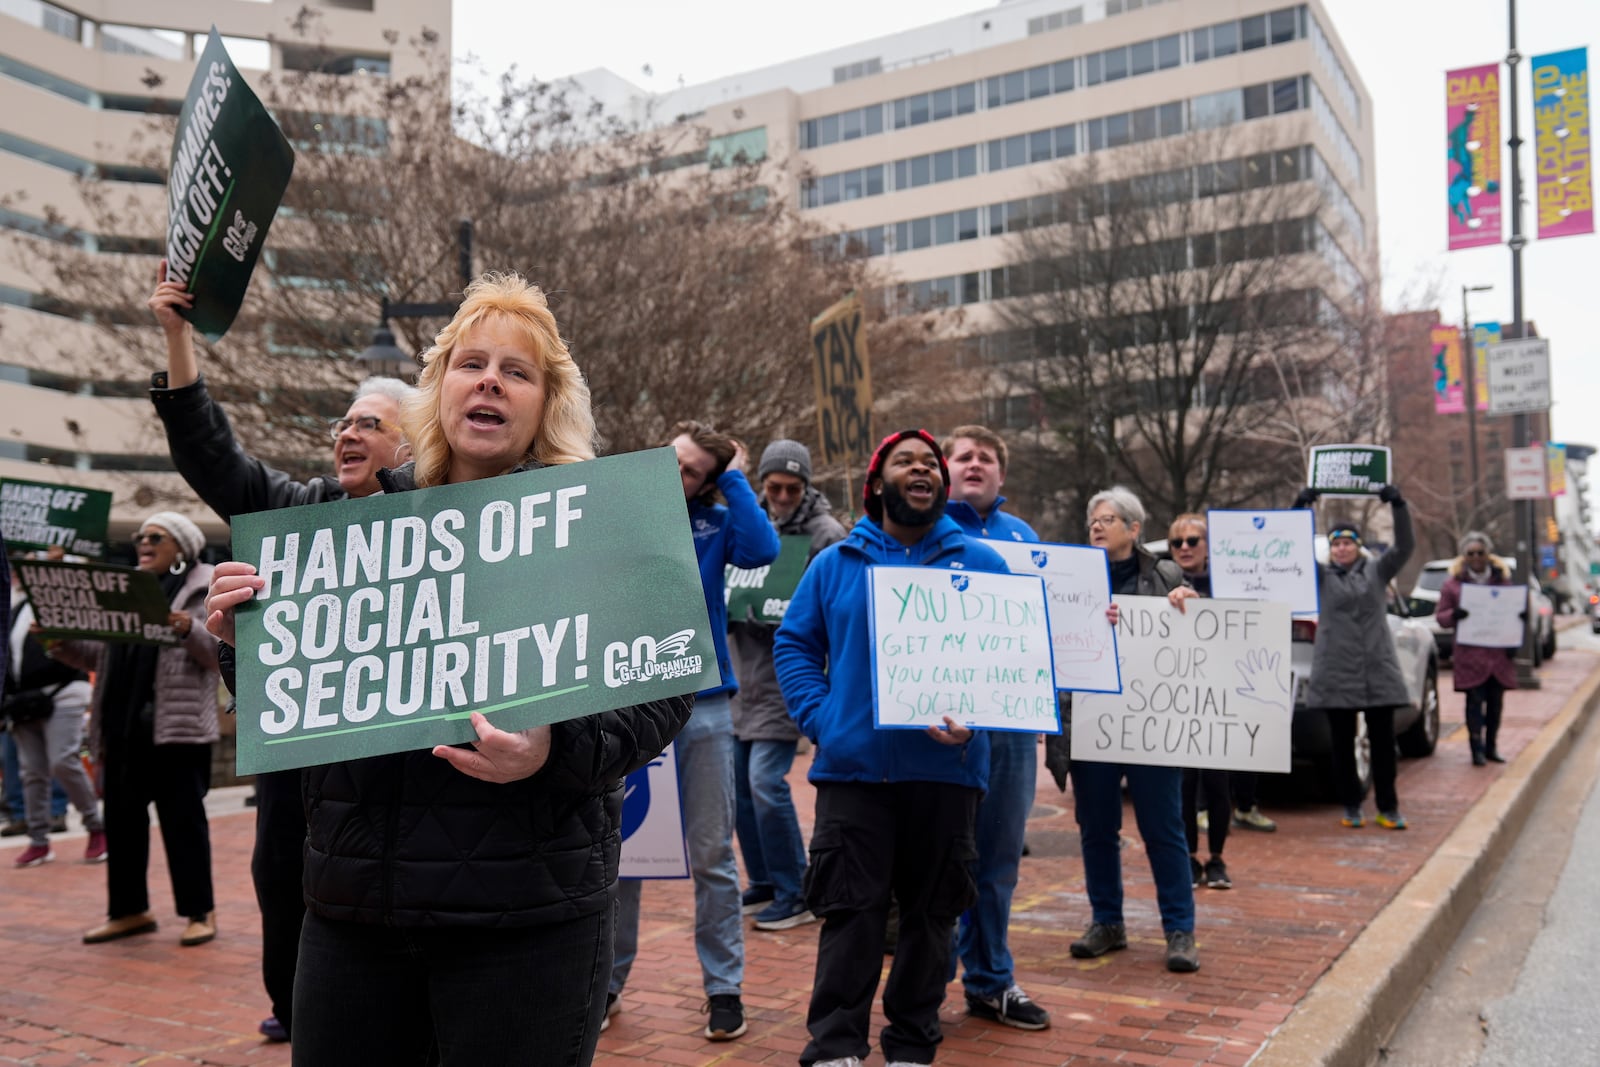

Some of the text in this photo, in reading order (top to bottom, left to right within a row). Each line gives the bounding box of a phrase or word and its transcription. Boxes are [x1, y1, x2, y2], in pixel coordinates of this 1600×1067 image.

[1447, 72, 1498, 99] CIAA
[1533, 64, 1566, 228] WELCOME TO
[1561, 70, 1592, 214] BALTIMORE
[188, 139, 232, 226] OFF!
[814, 310, 863, 398] TAX
[822, 407, 872, 464] RICH
[1351, 452, 1373, 466] OFF
[0, 482, 88, 512] HANDS OFF
[256, 484, 587, 600] HANDS OFF
[21, 565, 130, 593] HANDS OFF
[30, 586, 103, 610] SOCIAL
[891, 583, 947, 623] YOU
[38, 606, 142, 634] SECURITY!
[258, 573, 480, 666] SOCIAL
[1194, 609, 1262, 640] OFF
[882, 632, 1028, 656] GET MY VOTE
[260, 613, 589, 735] SECURITY!
[604, 635, 656, 688] GO
[619, 655, 702, 682] GET ORGANIZED
[661, 665, 702, 680] AFSCME
[1154, 646, 1207, 679] OUR
[887, 664, 922, 695] YOU
[986, 665, 1025, 684] HAVE
[897, 692, 987, 722] SOCIAL
[1127, 679, 1238, 717] SOCIAL
[1096, 713, 1260, 757] SECURITY
